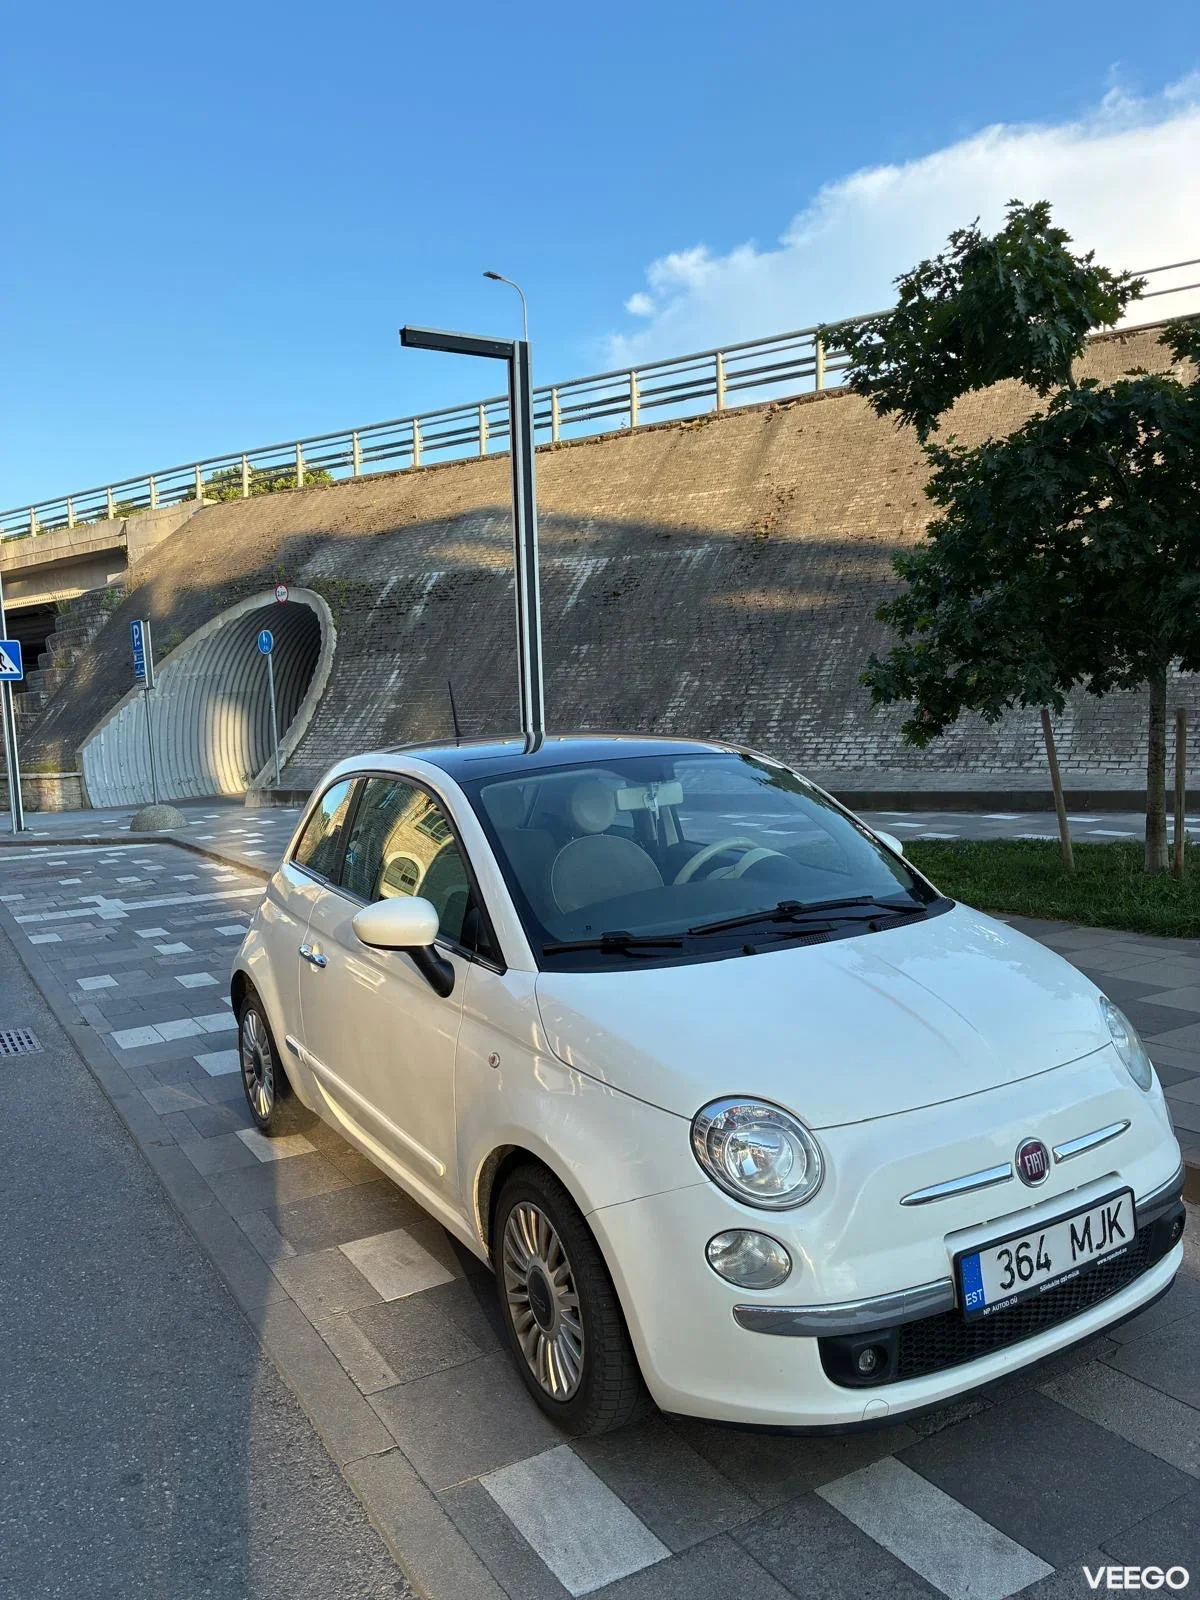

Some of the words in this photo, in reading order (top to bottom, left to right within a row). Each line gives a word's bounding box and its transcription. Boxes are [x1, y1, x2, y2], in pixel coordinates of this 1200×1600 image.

[1024, 1151, 1044, 1175] FIAT
[997, 1235, 1052, 1290] 364
[1069, 1201, 1126, 1261] MJK
[965, 1289, 984, 1306] EST
[983, 1307, 991, 1316] NP
